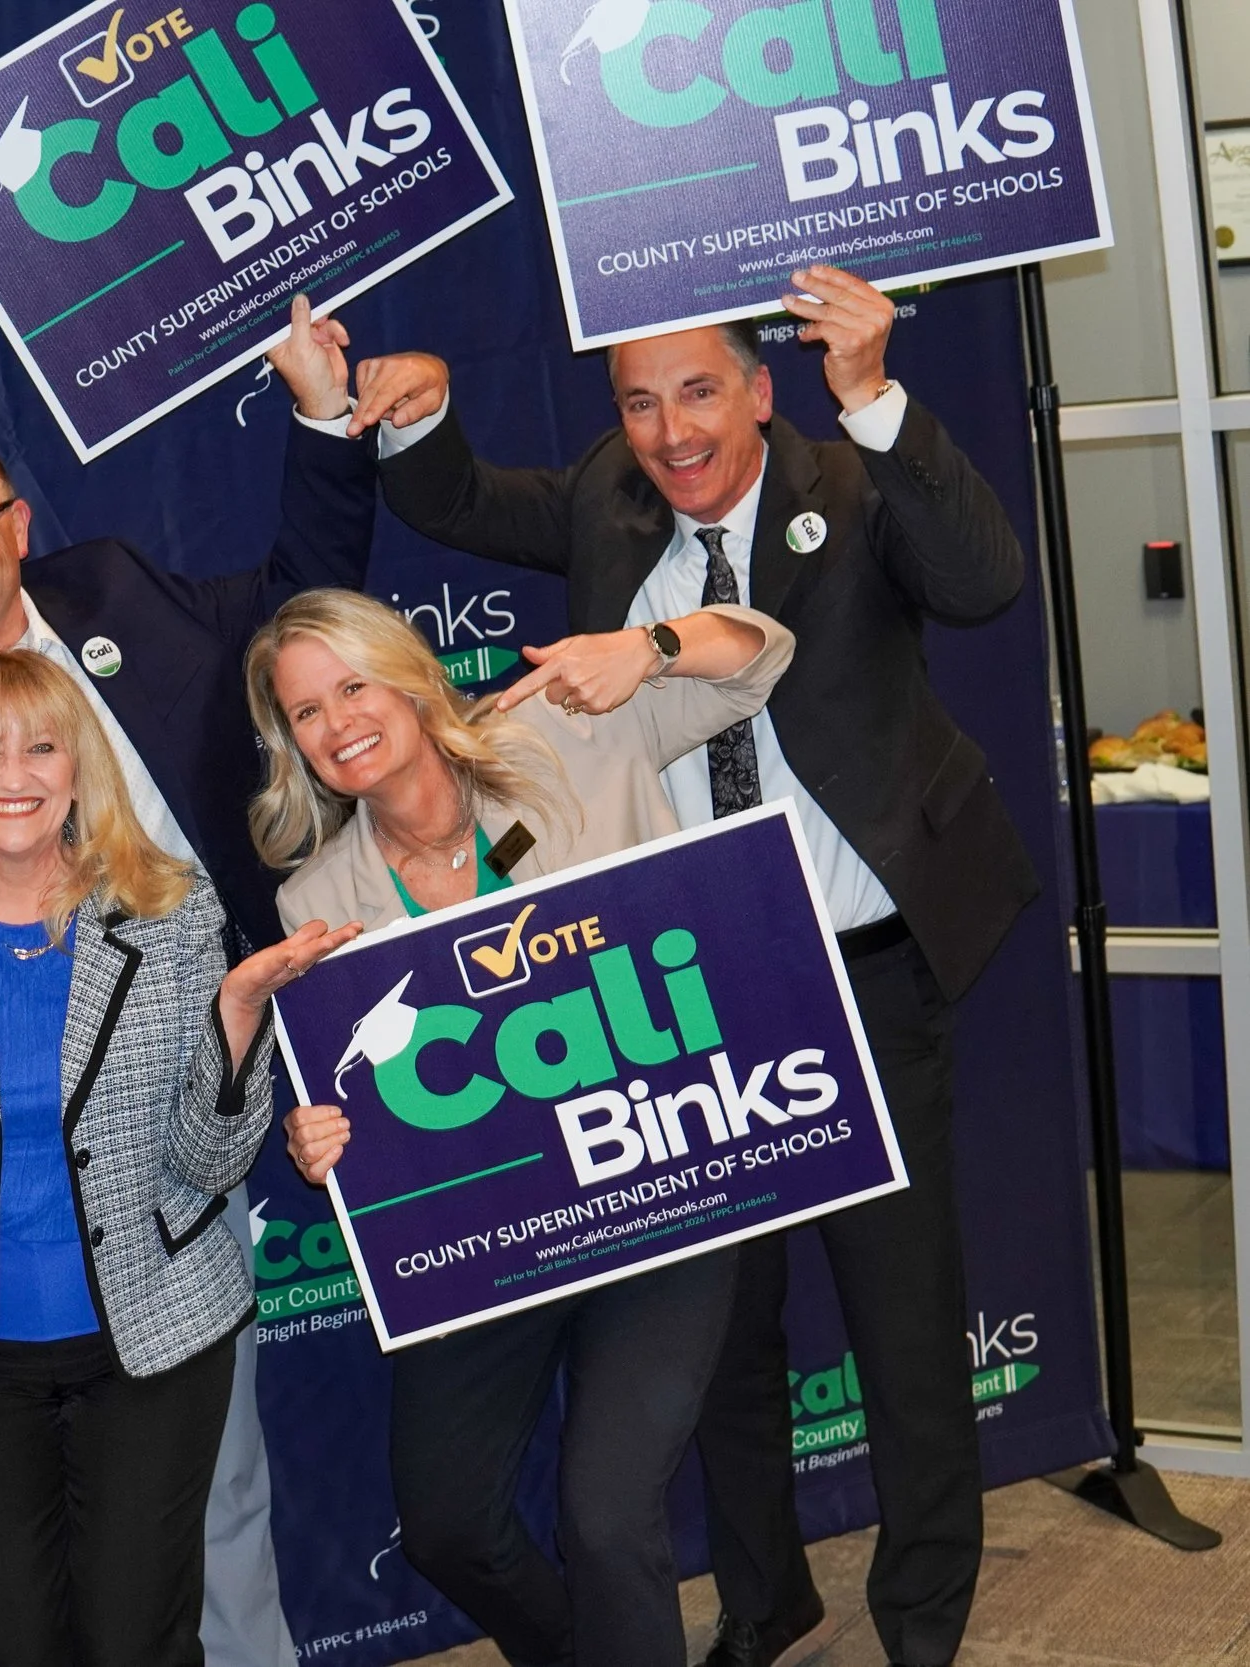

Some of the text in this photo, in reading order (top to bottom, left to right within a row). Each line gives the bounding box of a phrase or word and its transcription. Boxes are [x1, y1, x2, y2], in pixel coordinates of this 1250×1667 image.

[14, 3, 319, 242] Cali
[775, 82, 1055, 203] Binks
[185, 87, 432, 264] Binks
[597, 167, 1064, 275] COUNTY SUPERINTENDENT OF SCHOOLS
[76, 147, 452, 387] COUNTY SUPERINTENDENT OF SCHOOLS
[199, 240, 358, 341] www.Cali4CountySchools.com
[739, 227, 934, 274] www.Cali4CountySchools.com
[802, 518, 820, 543] Cali
[89, 643, 113, 660] Cali
[392, 582, 516, 647] nks
[374, 929, 723, 1130] Cali
[555, 1048, 839, 1187] Binks
[395, 1119, 852, 1277] COUNTY SUPERINTENDENT OF SCHOOLS
[493, 1275, 513, 1289] Paid
[512, 1270, 527, 1283] for
[525, 1267, 539, 1280] by
[537, 1261, 555, 1275] Cali
[553, 1254, 578, 1270] Binks
[576, 1250, 591, 1262] for
[589, 1240, 623, 1260] County
[620, 1220, 685, 1250] Superintendent
[683, 1213, 707, 1229] 2026
[710, 1204, 735, 1220] FPPC
[734, 1190, 779, 1213] #1484453
[536, 1193, 728, 1260] www.Cali4CountySchools.com
[256, 1308, 368, 1344] Bright Beginn
[792, 1419, 859, 1449] County
[808, 1441, 870, 1471] Beginnin
[313, 1632, 352, 1654] FPPC
[355, 1610, 428, 1641] #1484453
